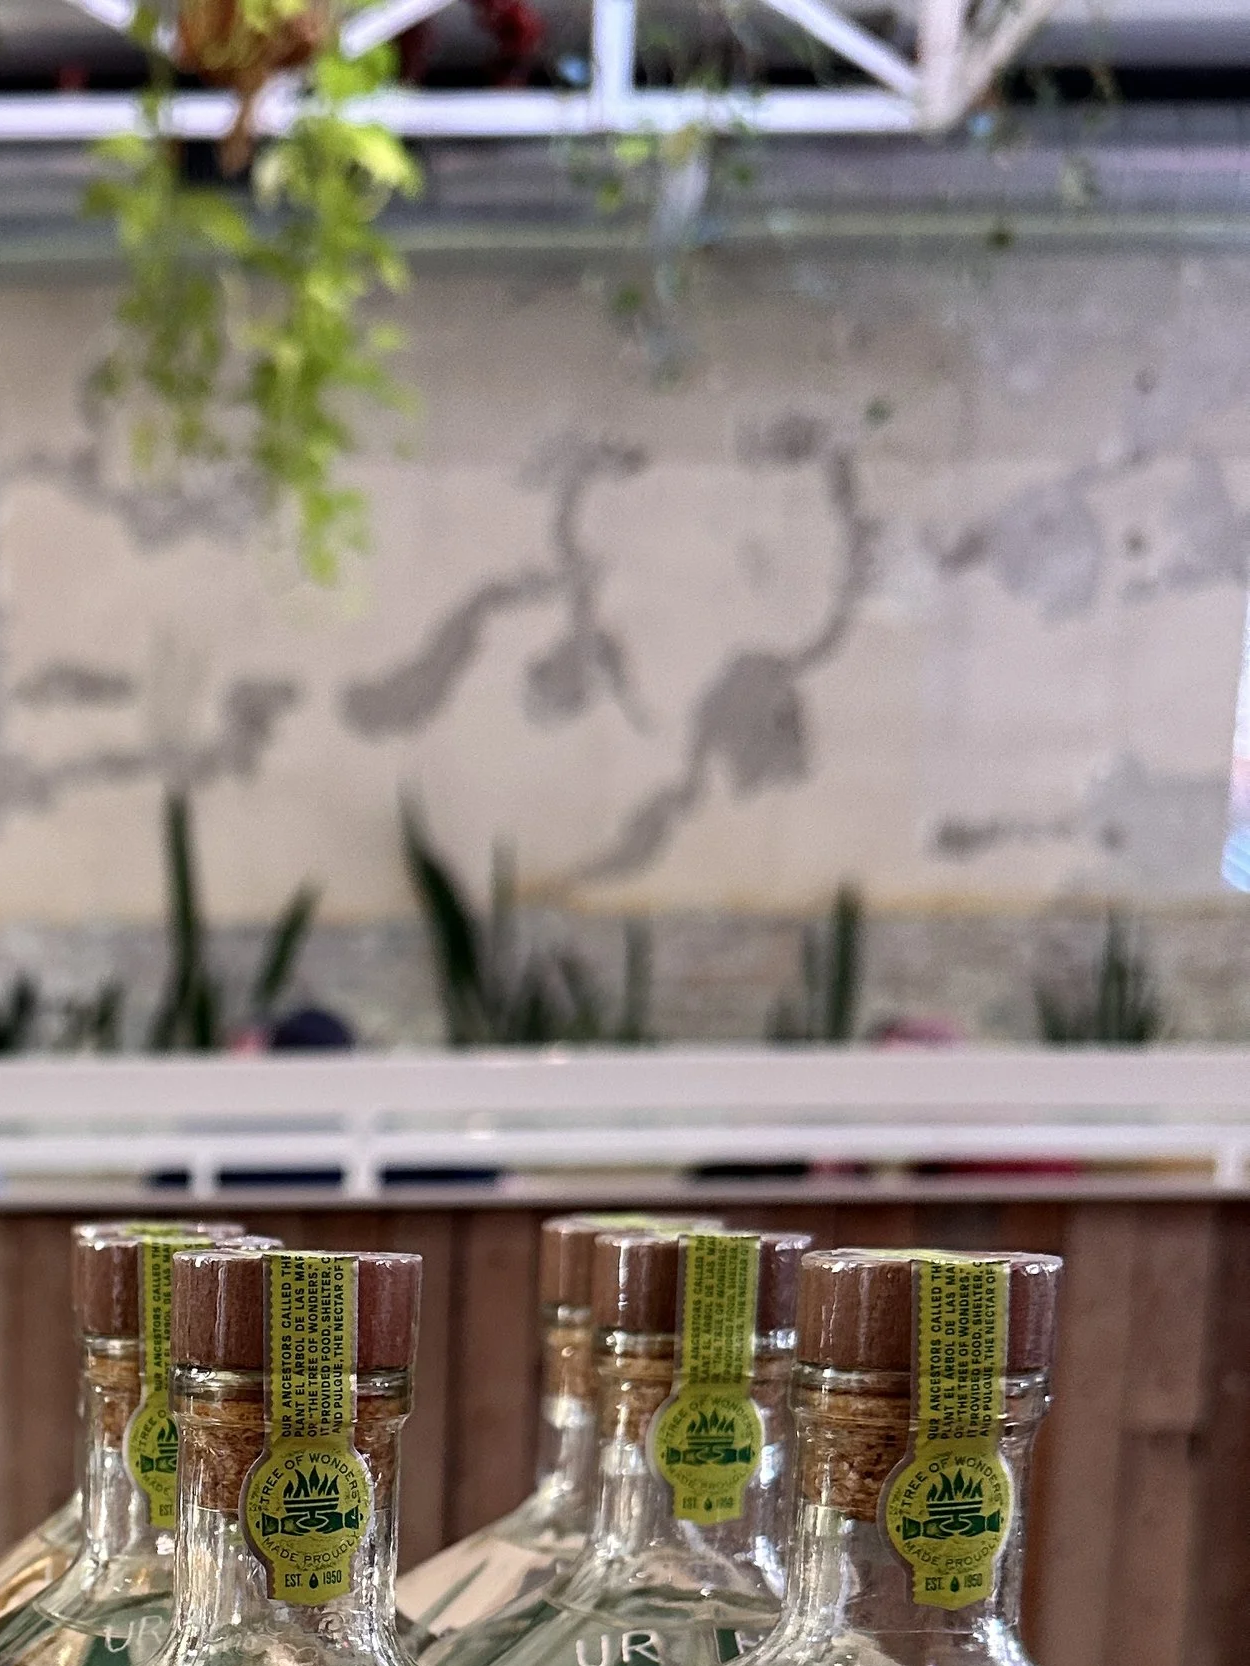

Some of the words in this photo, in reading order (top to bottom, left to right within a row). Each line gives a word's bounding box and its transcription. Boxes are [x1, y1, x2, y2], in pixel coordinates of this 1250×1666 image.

[334, 1265, 344, 1281] OF
[281, 1282, 292, 1329] CALLED
[294, 1287, 305, 1310] LAS
[321, 1267, 332, 1322] SHELTER,
[334, 1284, 344, 1332] NECTAR
[931, 1286, 942, 1333] CALLED
[295, 1316, 305, 1332] DE
[308, 1338, 318, 1353] OF
[321, 1325, 332, 1362] FOOD,
[333, 1335, 344, 1358] THE
[282, 1335, 292, 1408] ANCESTORS
[308, 1357, 318, 1387] TREE
[333, 1359, 344, 1409] PULQUE,
[930, 1339, 942, 1411] ANCESTORS
[295, 1382, 305, 1395] EL
[321, 1365, 331, 1425] PROVIDED
[282, 1415, 292, 1437] OUR
[294, 1401, 305, 1437] PLANT
[307, 1422, 318, 1437] OR
[320, 1426, 330, 1436] IT
[331, 1411, 343, 1434] AND
[927, 1418, 939, 1440] OUR
[260, 1467, 285, 1505] TREE
[284, 1454, 304, 1471] OF
[901, 1471, 928, 1509] TREE
[928, 1458, 950, 1474] OF
[262, 1537, 299, 1563] MADE
[303, 1533, 362, 1565] PROUDLY
[903, 1541, 941, 1566] MADE
[284, 1573, 304, 1588] EST.
[322, 1570, 342, 1585] 1950
